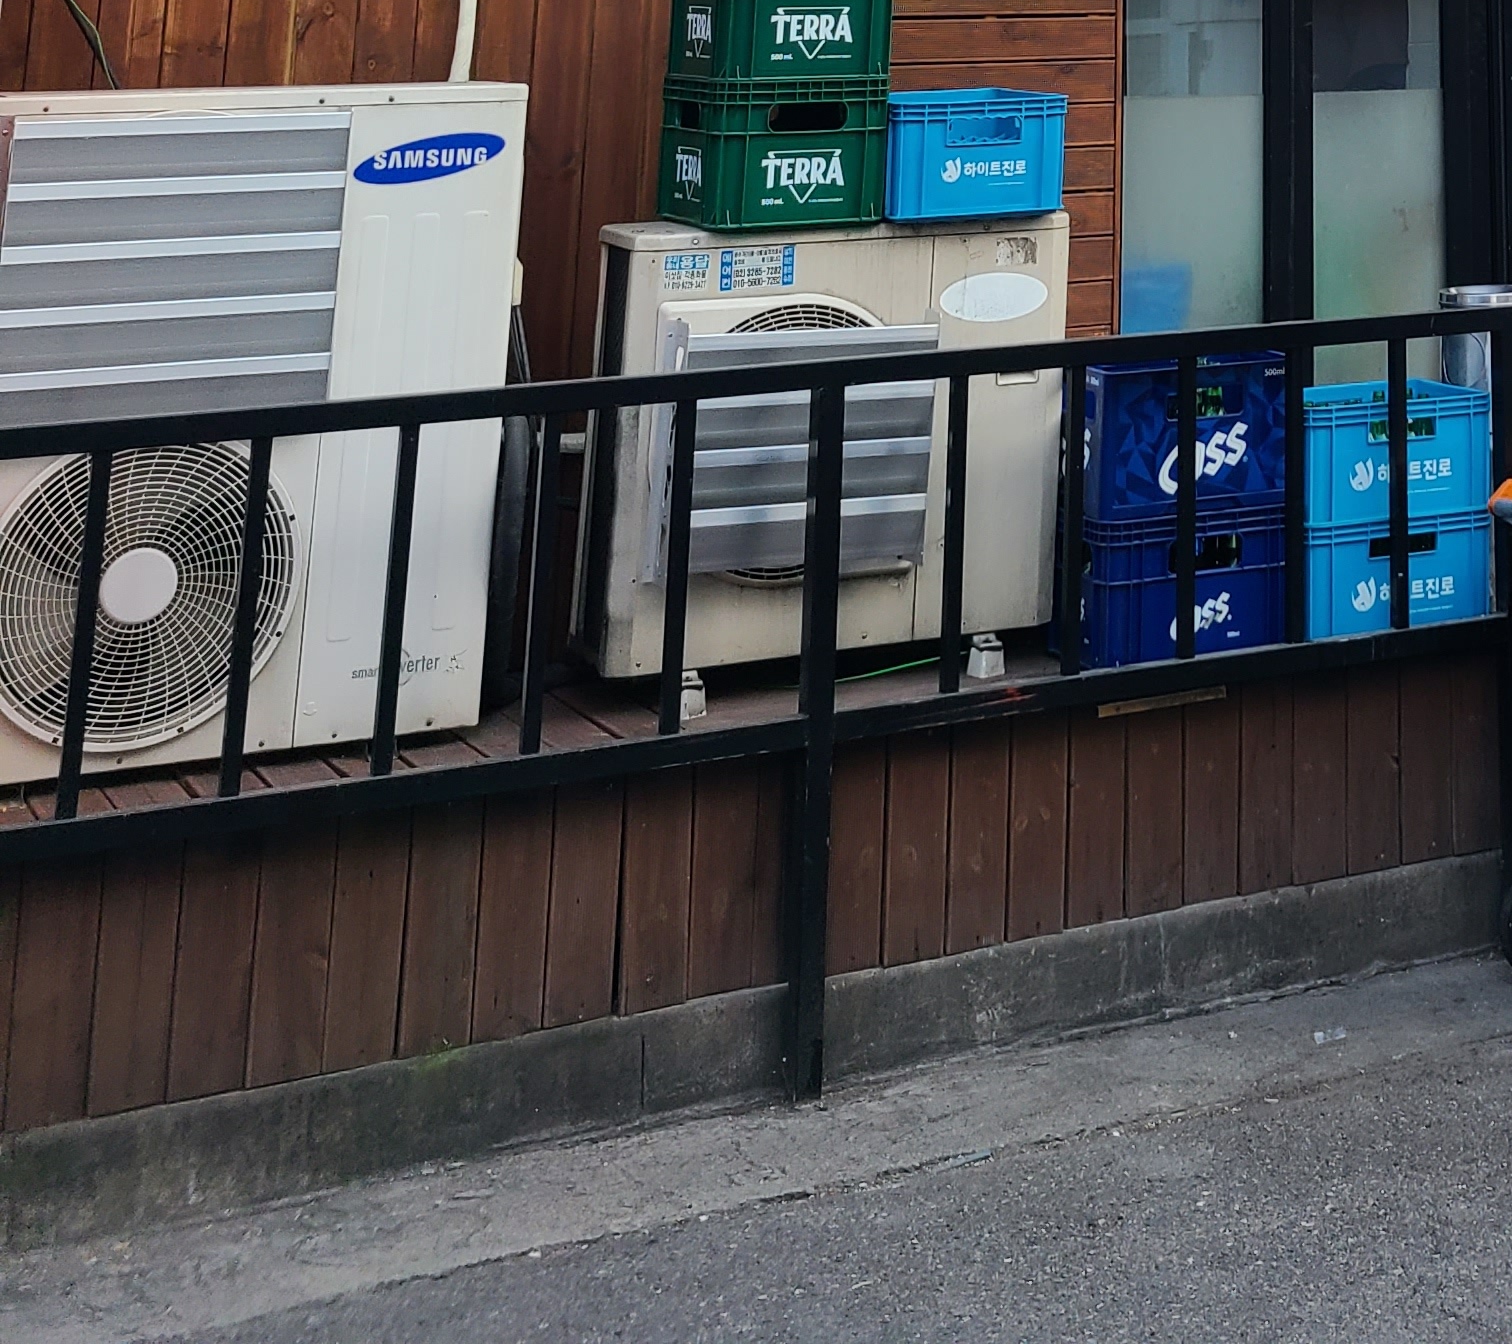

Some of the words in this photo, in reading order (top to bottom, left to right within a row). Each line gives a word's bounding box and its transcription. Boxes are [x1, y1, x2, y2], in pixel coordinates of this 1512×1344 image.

[686, 13, 712, 44] TERRA
[770, 13, 853, 45] TERRA
[373, 146, 488, 171] SAMSUNG
[675, 153, 702, 187] TERRA
[963, 160, 1027, 178] 하이트진로
[761, 156, 845, 189] TERRA
[1377, 457, 1453, 484] 하트진로
[1379, 575, 1455, 602] 하트진로
[351, 666, 379, 679] smar
